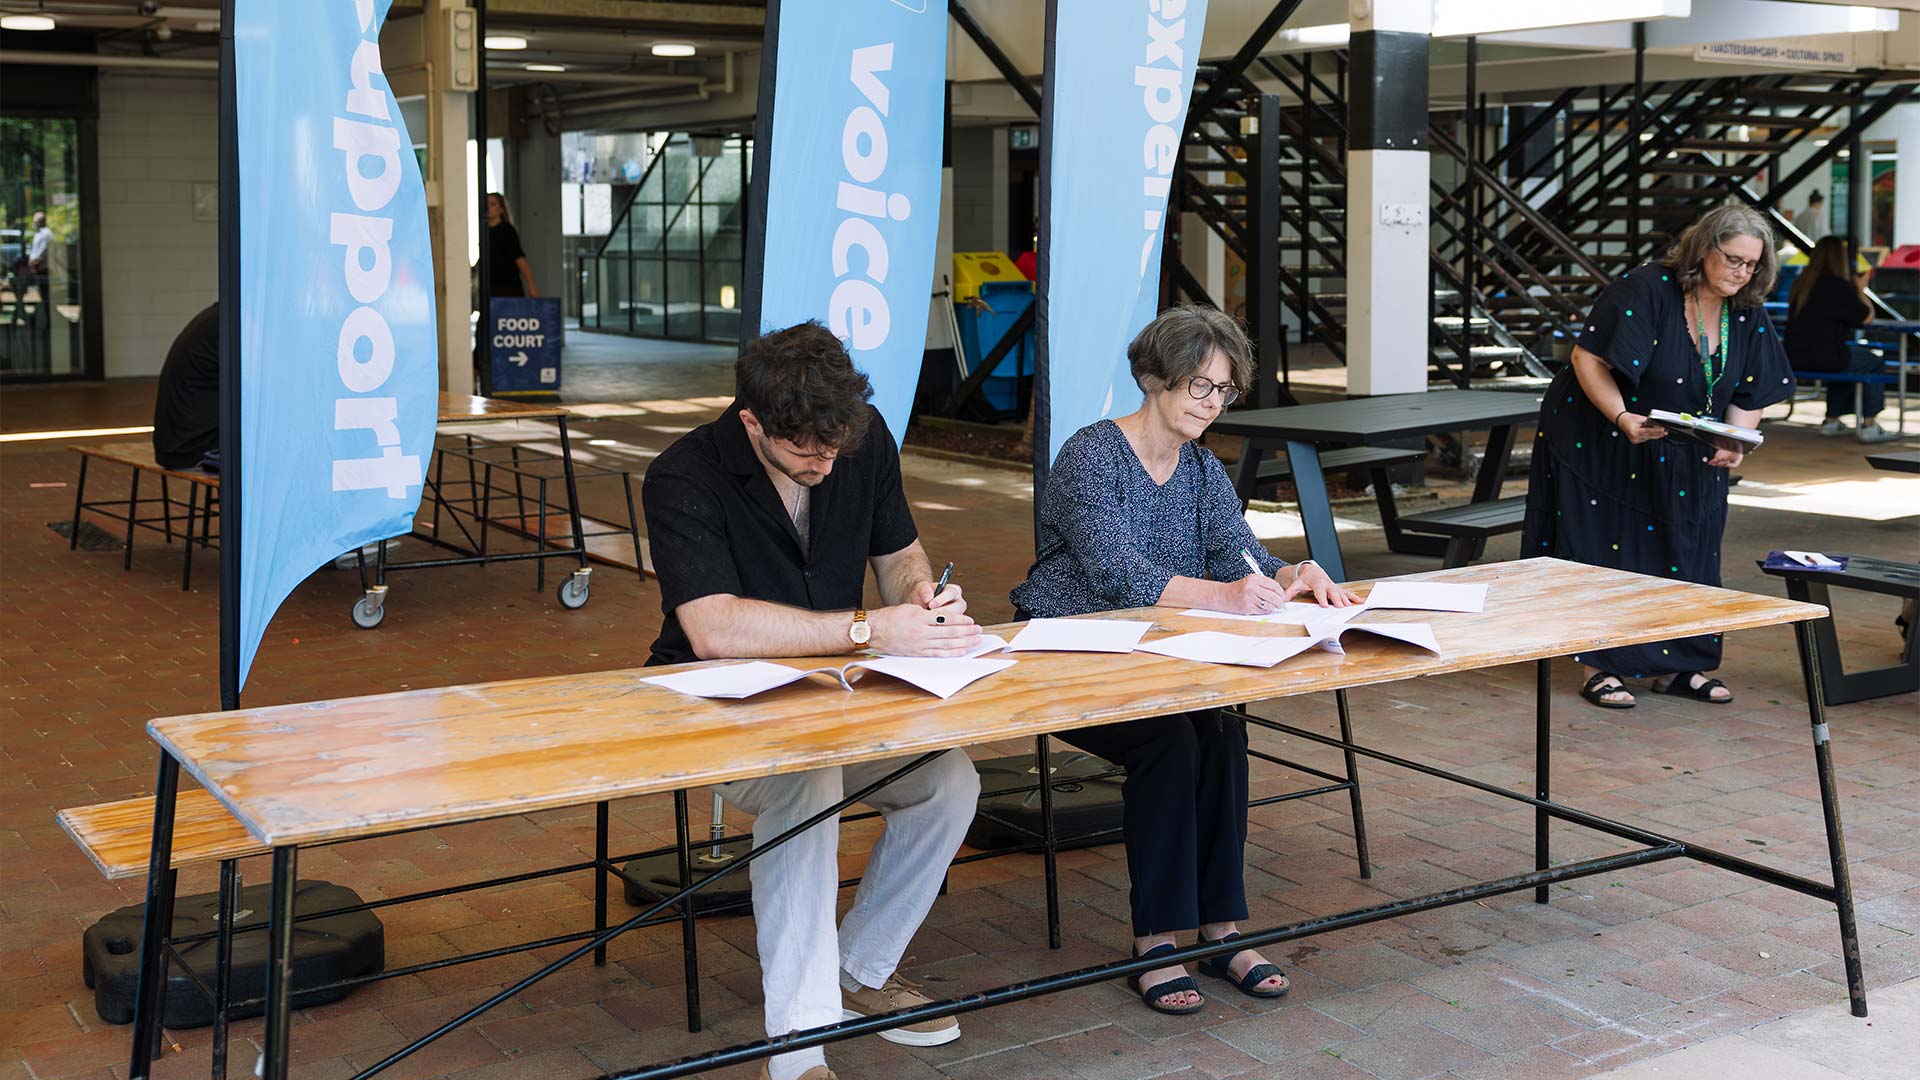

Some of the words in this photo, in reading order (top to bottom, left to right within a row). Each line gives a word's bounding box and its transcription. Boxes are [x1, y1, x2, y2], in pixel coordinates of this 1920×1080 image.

[829, 43, 911, 350] voice
[498, 318, 540, 331] FOOD
[493, 334, 545, 348] COURT
